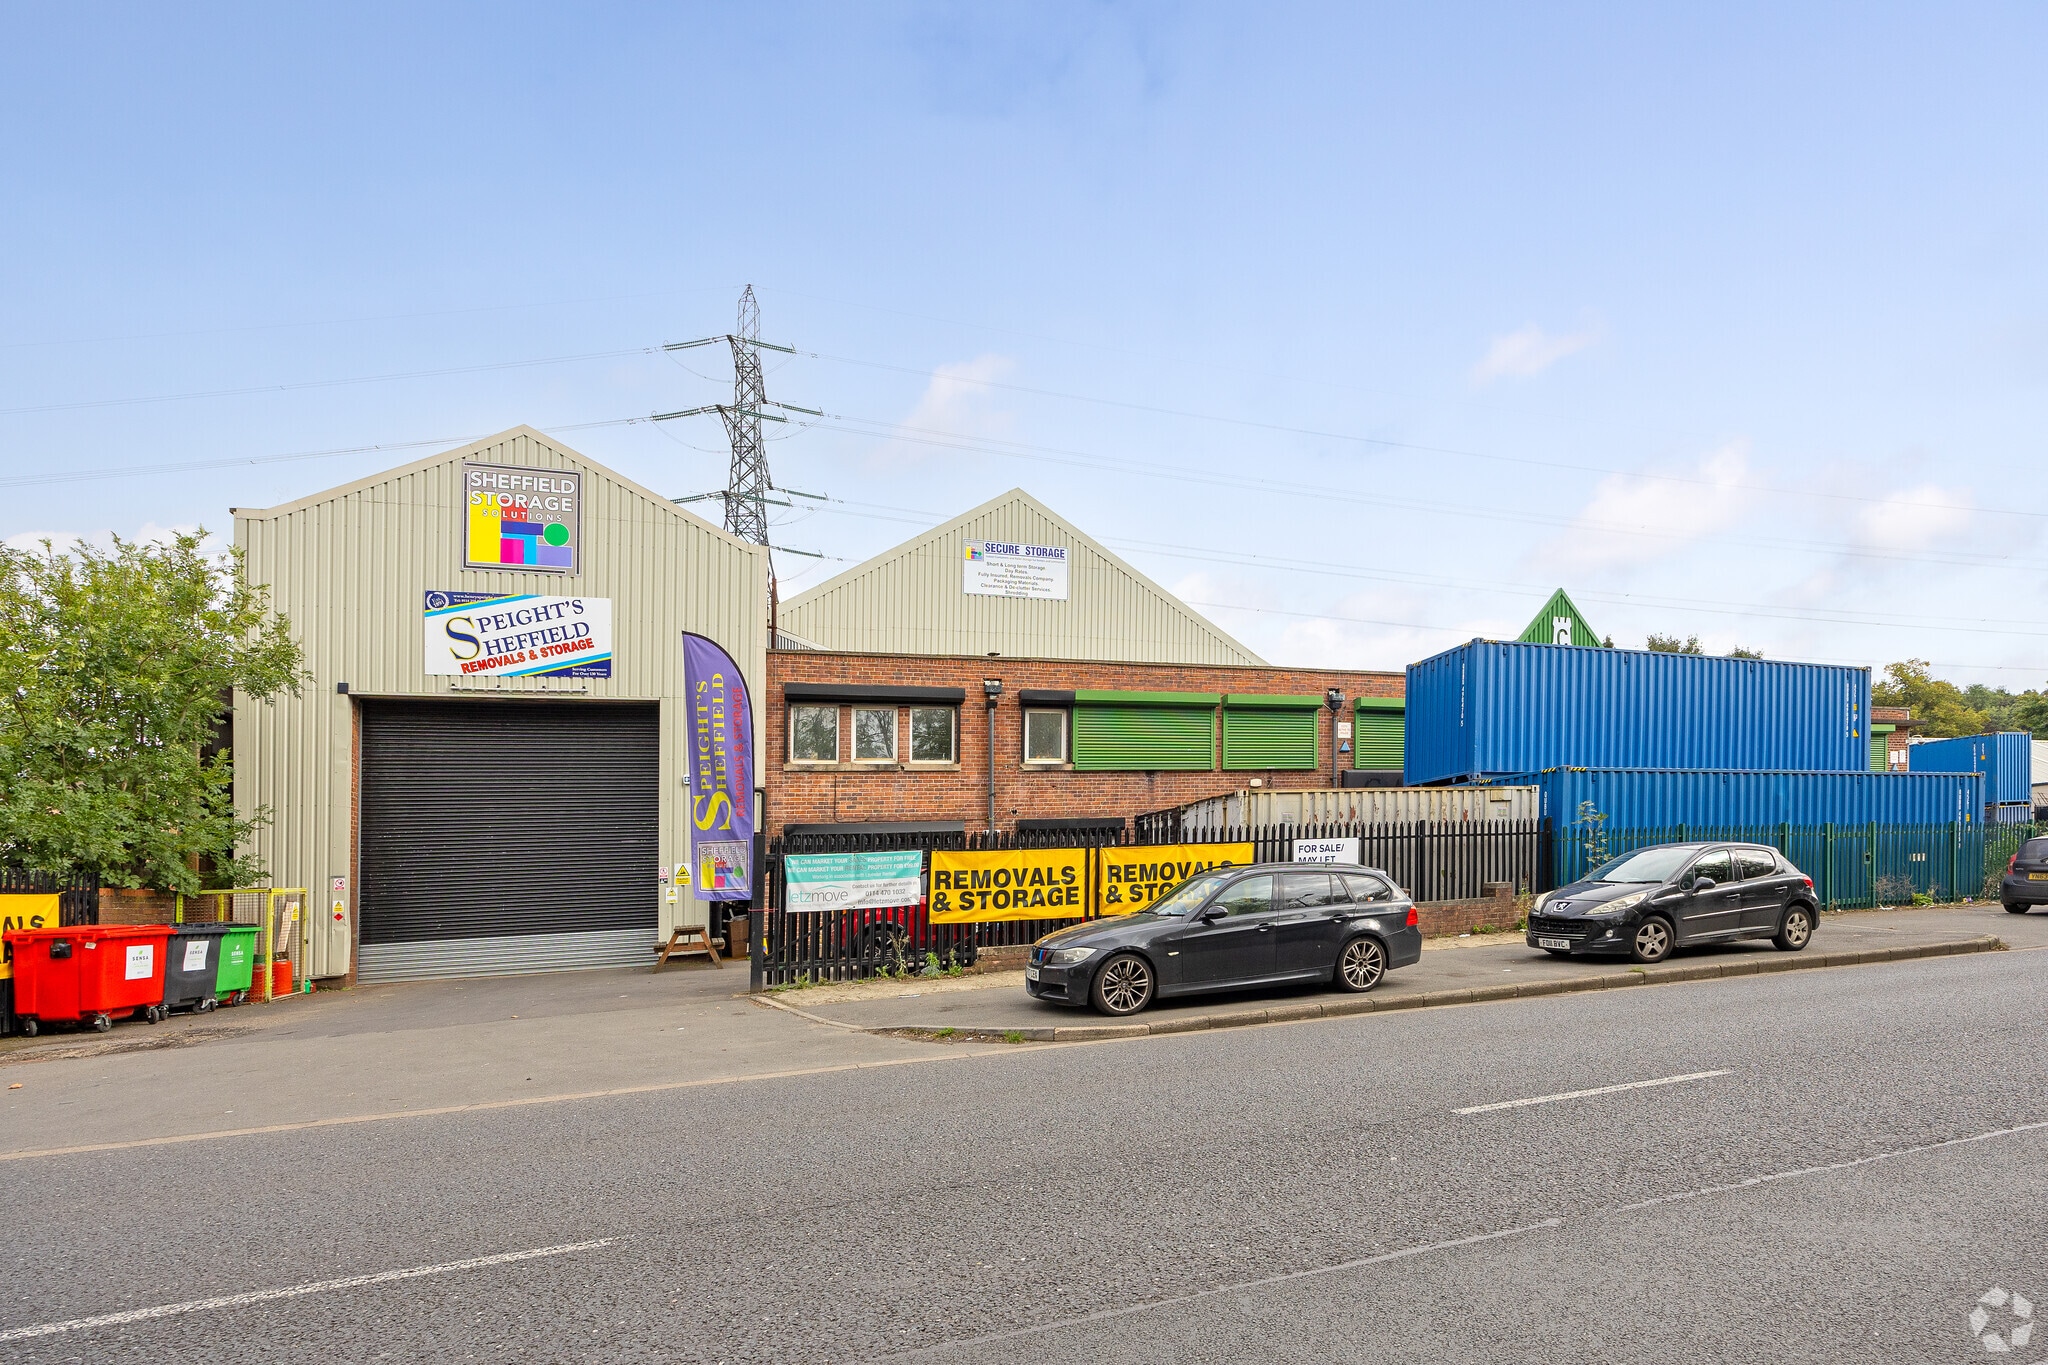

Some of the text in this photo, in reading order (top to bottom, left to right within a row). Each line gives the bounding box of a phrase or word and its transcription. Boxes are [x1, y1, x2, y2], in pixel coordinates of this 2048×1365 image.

[470, 472, 575, 494] SHEFFIELD
[470, 490, 573, 512] STORAGE
[482, 509, 562, 522] SOLUTIONS
[985, 542, 1065, 558] SECURE STORAGE
[461, 638, 595, 674] REMOVALS & STORAGE
[732, 687, 745, 817] REMOVALS & STORAGE
[702, 846, 746, 855] SHEFFIELD
[1298, 843, 1345, 853] FOR SALE/
[702, 855, 746, 864] STORAGE
[934, 865, 1076, 890] REMOVALS
[788, 888, 848, 904] letzmove
[932, 886, 1080, 913] & STORAGE
[1105, 884, 1123, 904] &
